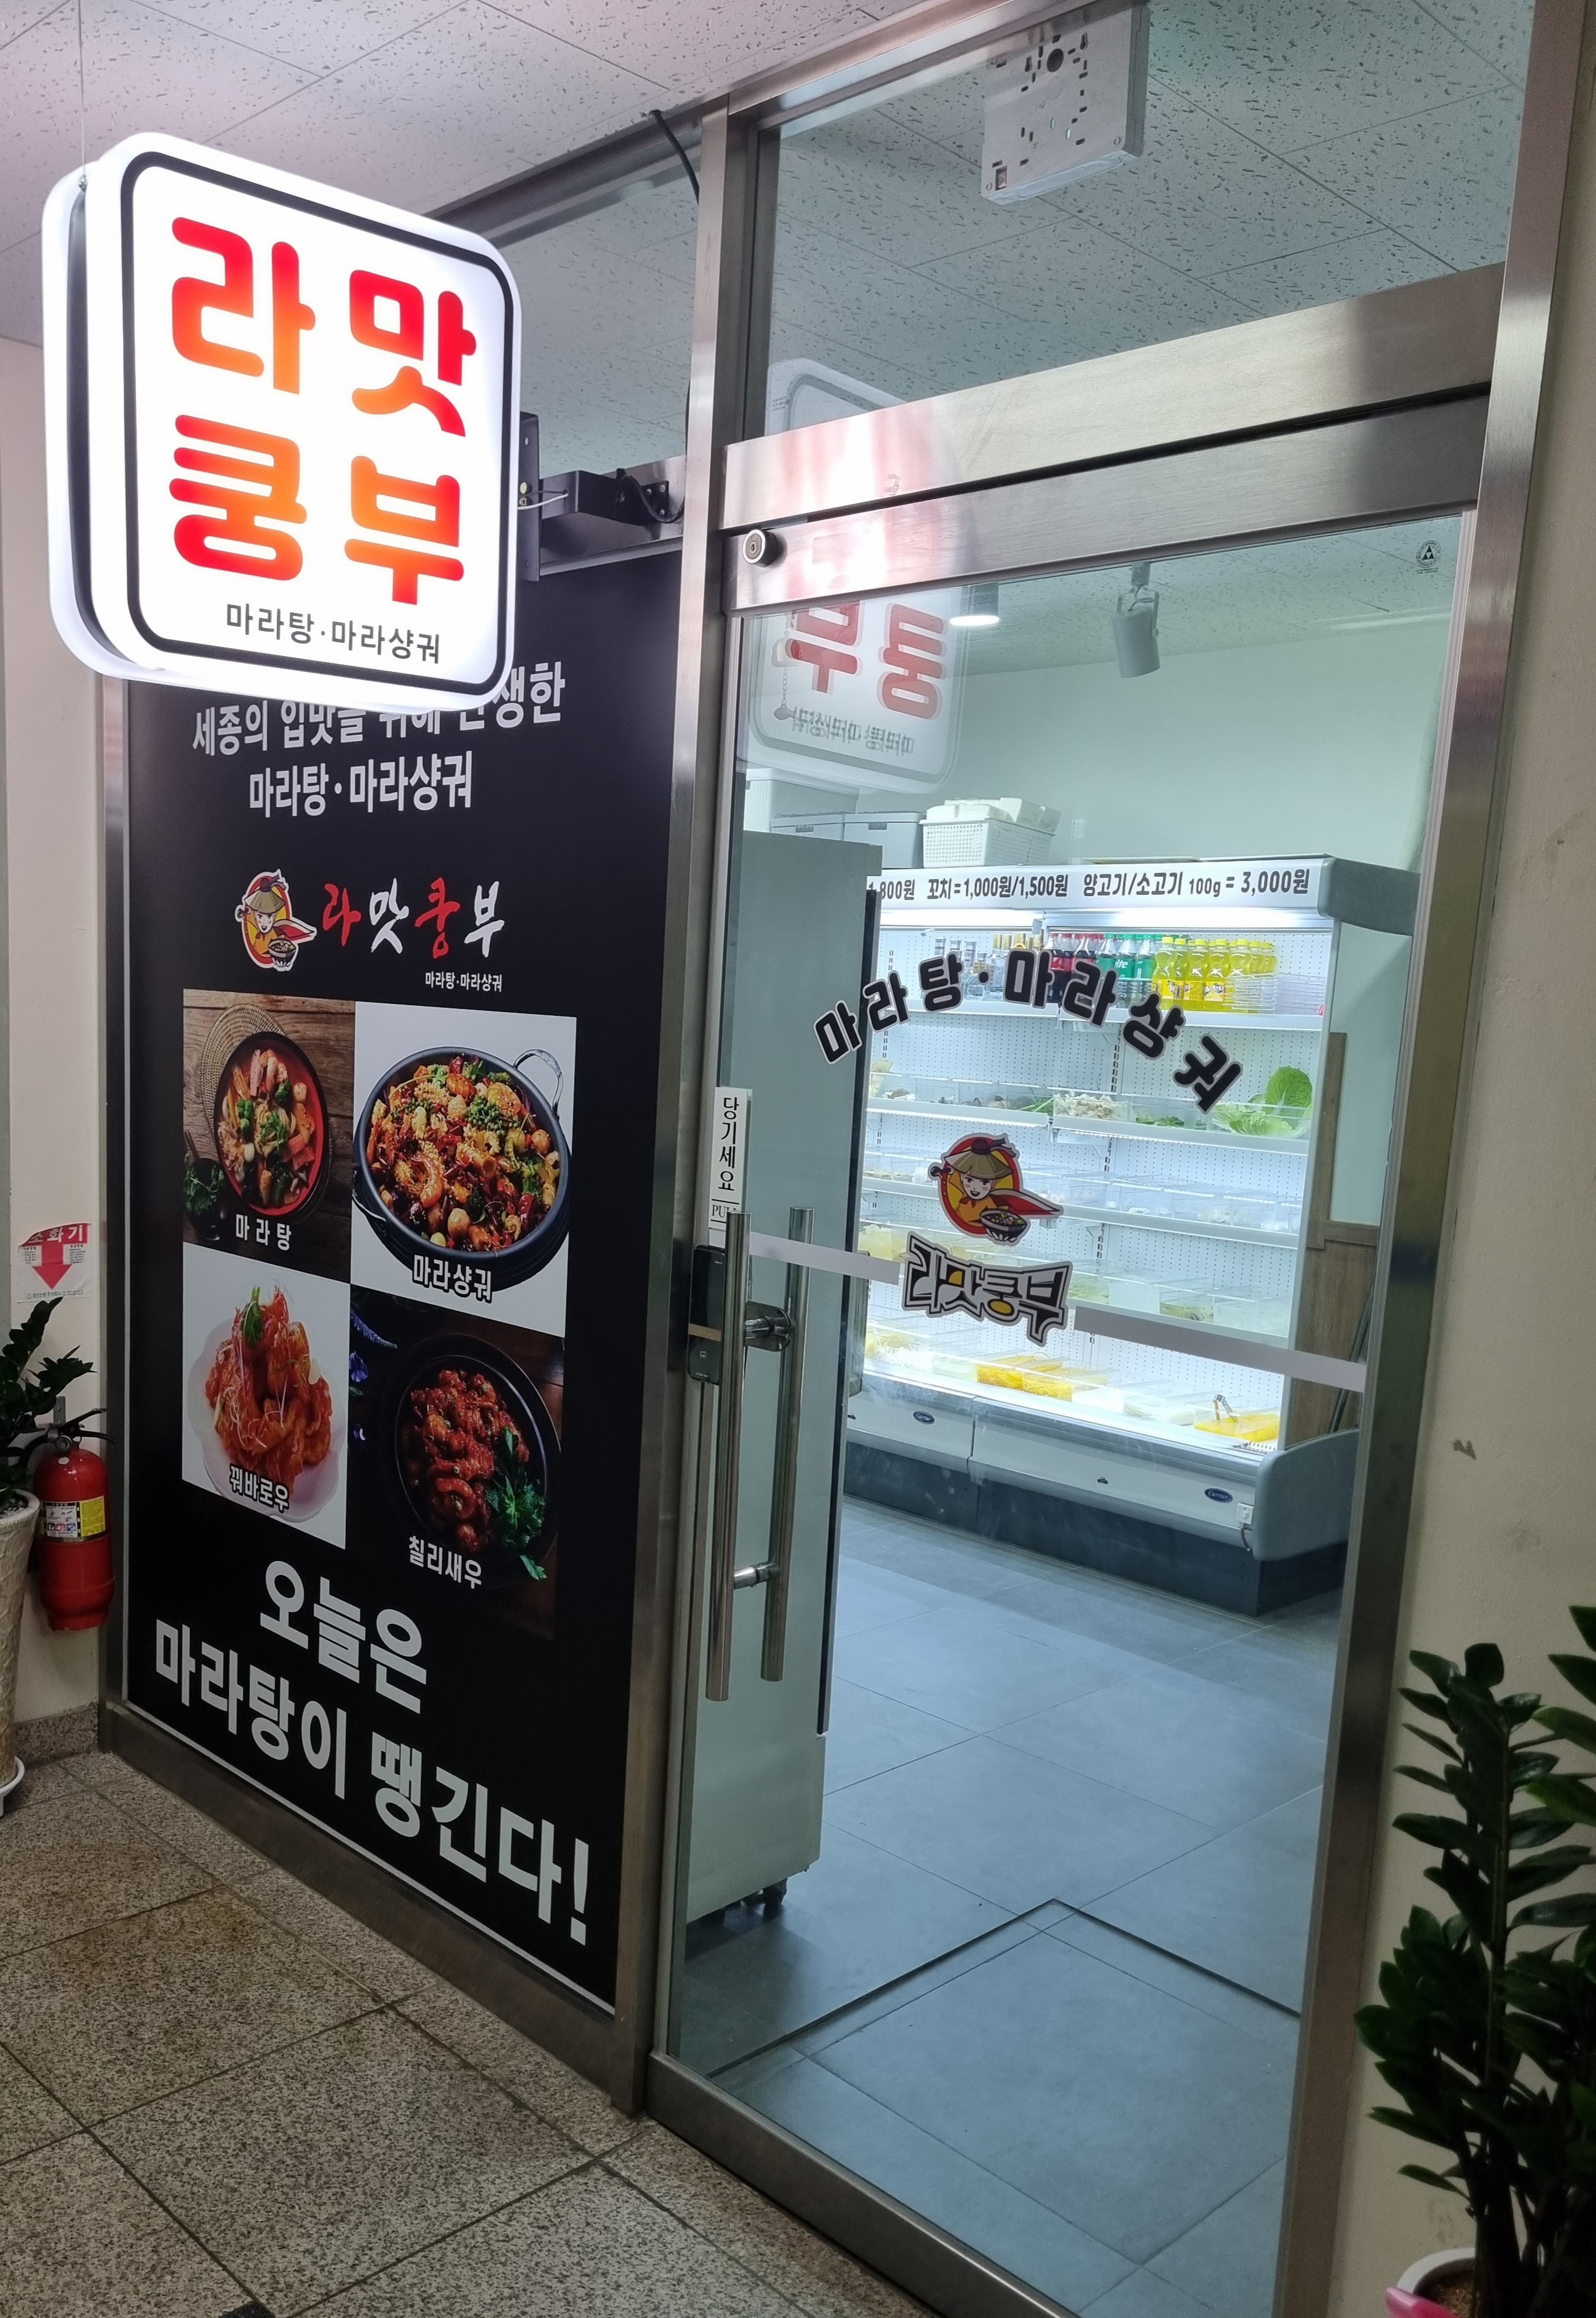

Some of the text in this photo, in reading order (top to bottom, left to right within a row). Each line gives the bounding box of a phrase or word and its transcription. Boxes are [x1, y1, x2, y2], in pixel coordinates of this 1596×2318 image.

[172, 217, 477, 437] 라맛
[169, 414, 464, 605] 쿵부
[227, 603, 440, 664] 마라탕·마라샹궈
[192, 700, 268, 756] 세종의
[250, 751, 472, 817] 마라탕·마라샹궈
[1083, 871, 1184, 897] 양고기/소고기
[1189, 877, 1221, 897] 100g
[1240, 869, 1310, 897] 3,000원
[425, 971, 502, 992] 마라탕·마라샹궈
[815, 948, 1243, 1114] 마라탕·마라샹궈
[718, 1096, 741, 1192] 당기세요
[27, 1224, 83, 1243] 소화기
[235, 1214, 292, 1251] 마라탕
[413, 1255, 493, 1301] 마라샹궈
[230, 1464, 289, 1511] 꿔바로우
[1207, 1490, 1229, 1500] Carrier
[409, 1536, 482, 1589] 칠리새우
[260, 1560, 427, 1715] 오늘은
[155, 1619, 589, 1946] 마라탕이 땡긴다!
